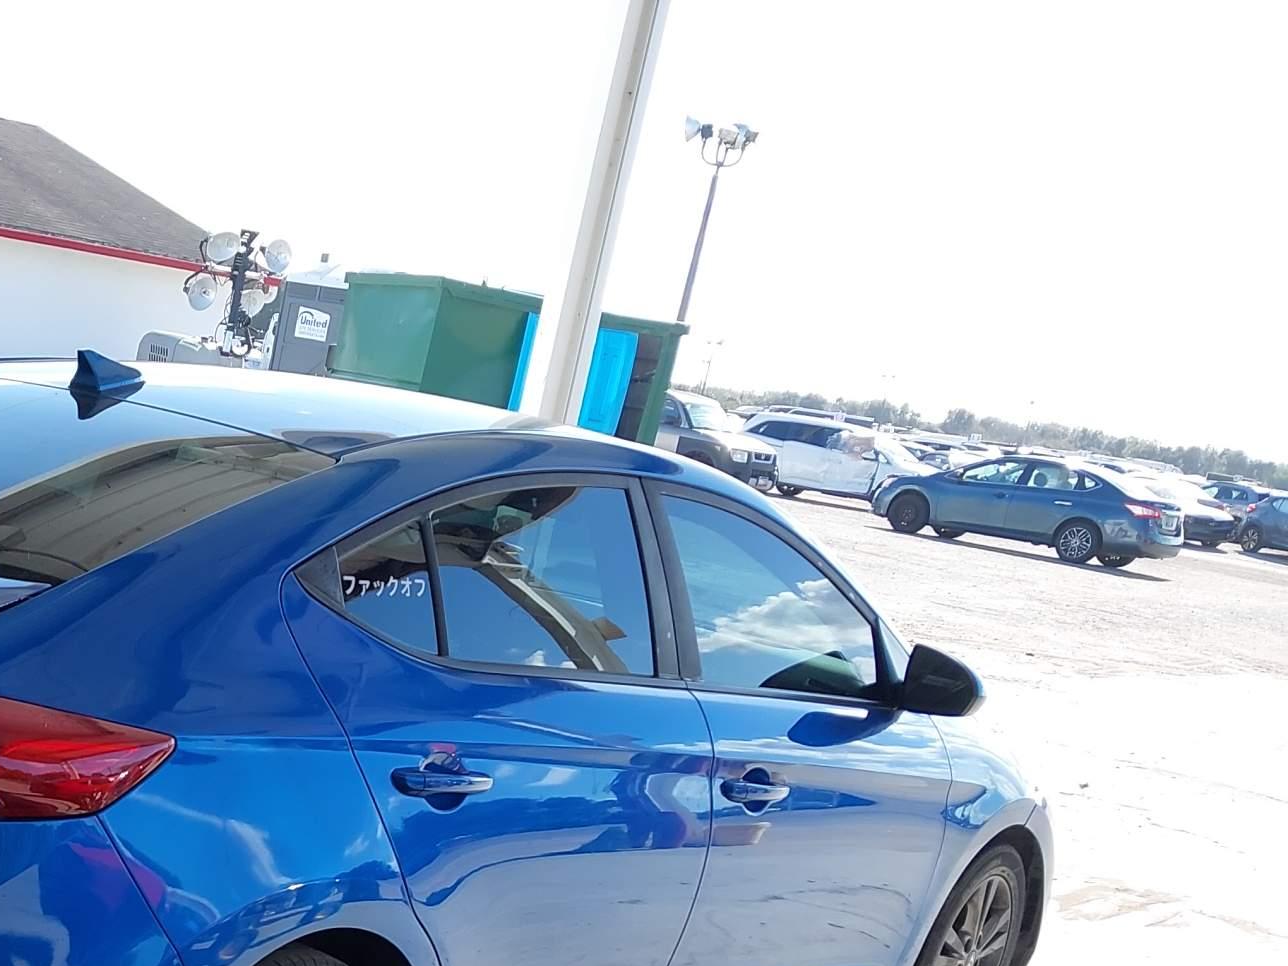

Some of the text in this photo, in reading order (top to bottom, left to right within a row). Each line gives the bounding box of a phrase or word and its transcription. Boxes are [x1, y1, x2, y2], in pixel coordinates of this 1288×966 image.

[342, 575, 426, 597] ファックオフ
